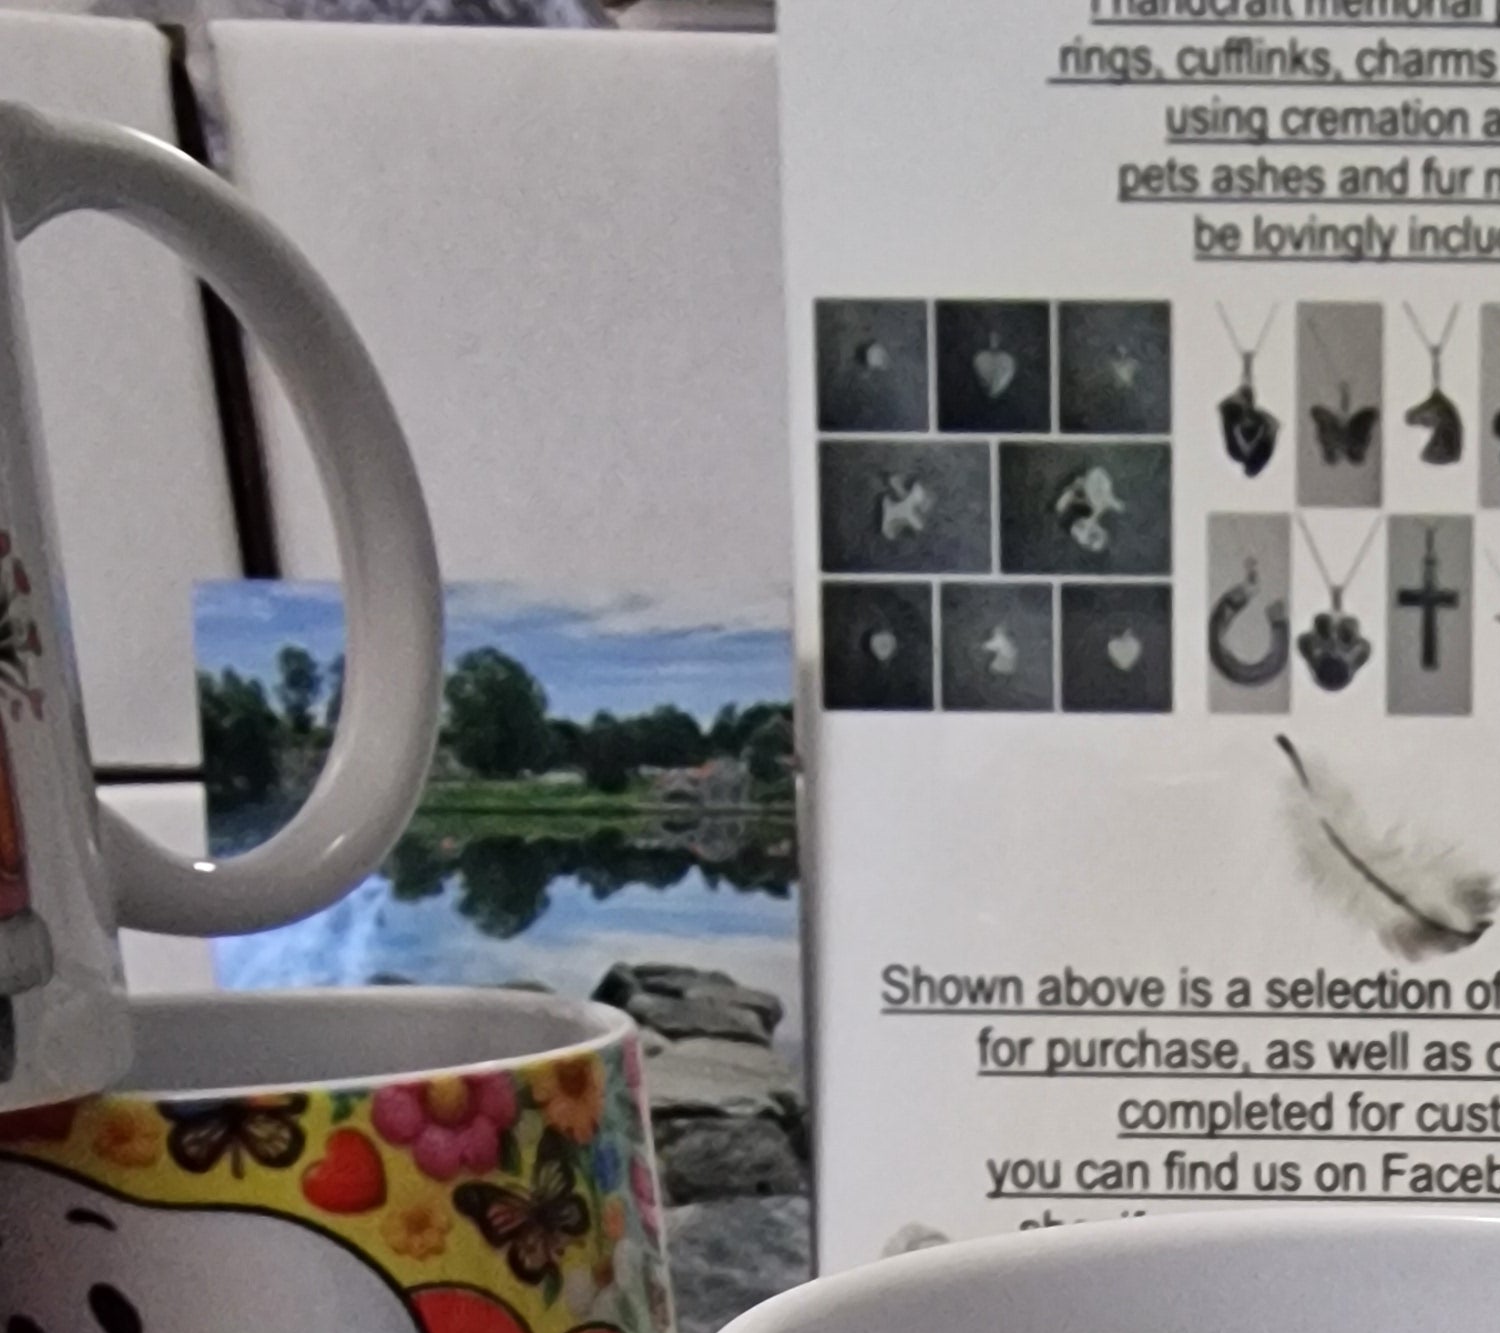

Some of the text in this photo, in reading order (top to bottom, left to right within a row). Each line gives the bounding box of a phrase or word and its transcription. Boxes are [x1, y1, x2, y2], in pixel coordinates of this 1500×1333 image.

[1059, 38, 1165, 82] rings,
[1177, 36, 1343, 83] cufflinks,
[1356, 38, 1497, 80] charms
[1165, 98, 1269, 143] using
[1281, 100, 1469, 138] cremation
[1118, 160, 1199, 201] pets
[1211, 158, 1326, 196] ashes
[1338, 158, 1410, 196] and
[1421, 158, 1471, 196] fur
[1195, 216, 1239, 254] be
[1252, 216, 1397, 260] lovingly
[881, 964, 1023, 1007] Shown
[1037, 966, 1165, 1008] above
[1179, 966, 1213, 1008] is
[1226, 976, 1251, 1008] a
[1266, 967, 1451, 1010] selection
[978, 1027, 1034, 1069] for
[1045, 1028, 1251, 1077] purchase,
[1265, 1038, 1315, 1070] as
[1328, 1032, 1409, 1071] well
[1423, 1039, 1473, 1072] as
[1118, 1091, 1333, 1138] completed
[1348, 1091, 1402, 1132] for
[986, 1157, 1061, 1197] you
[1075, 1159, 1150, 1190] can
[1164, 1151, 1238, 1190] find
[1253, 1162, 1302, 1192] us
[1315, 1162, 1366, 1192] on
